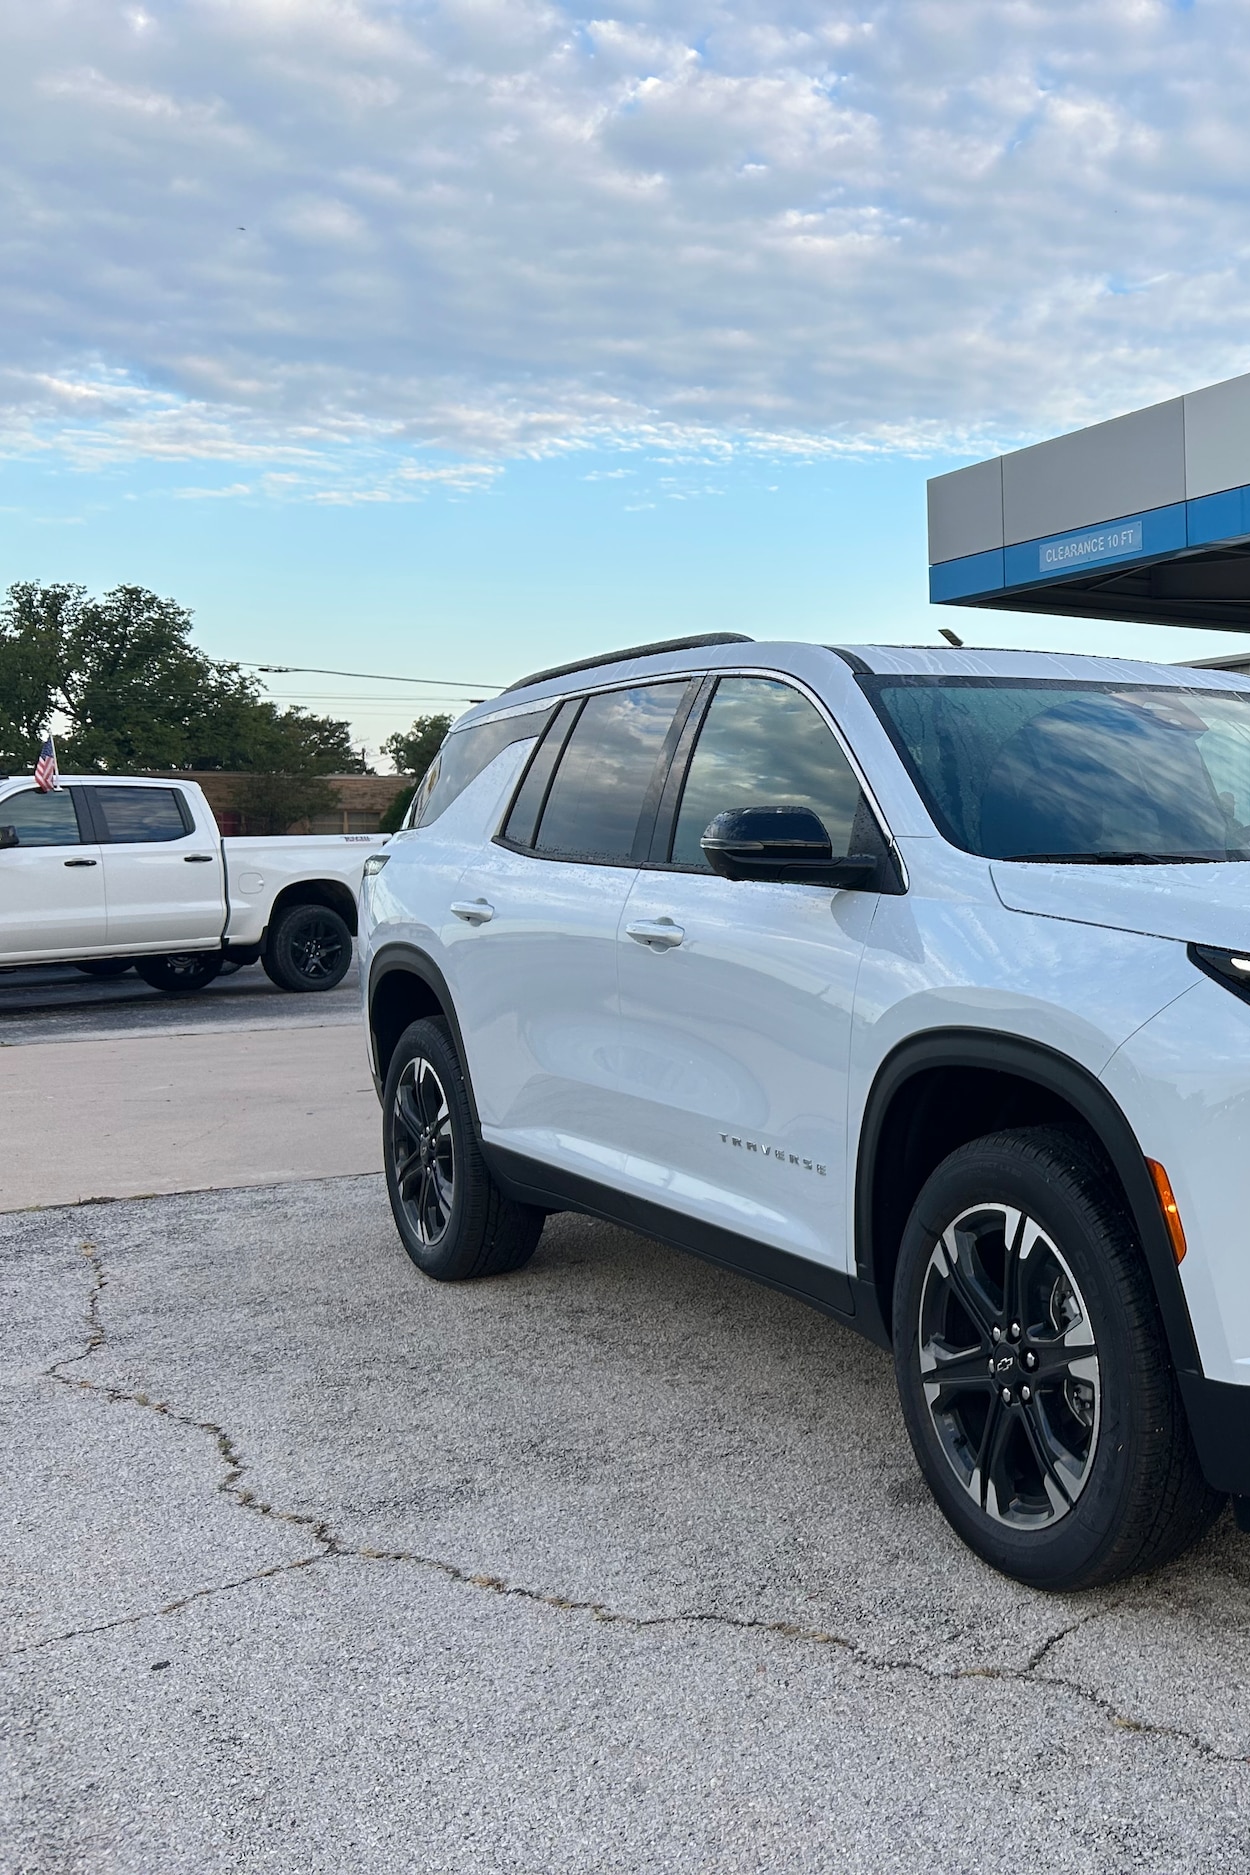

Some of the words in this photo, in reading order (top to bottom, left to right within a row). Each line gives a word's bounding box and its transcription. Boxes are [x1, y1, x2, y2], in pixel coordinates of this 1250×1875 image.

[1045, 536, 1105, 563] CLEARANCE
[1107, 534, 1119, 549] 10
[1121, 529, 1134, 546] FT
[717, 1131, 827, 1176] TRAVERSE
